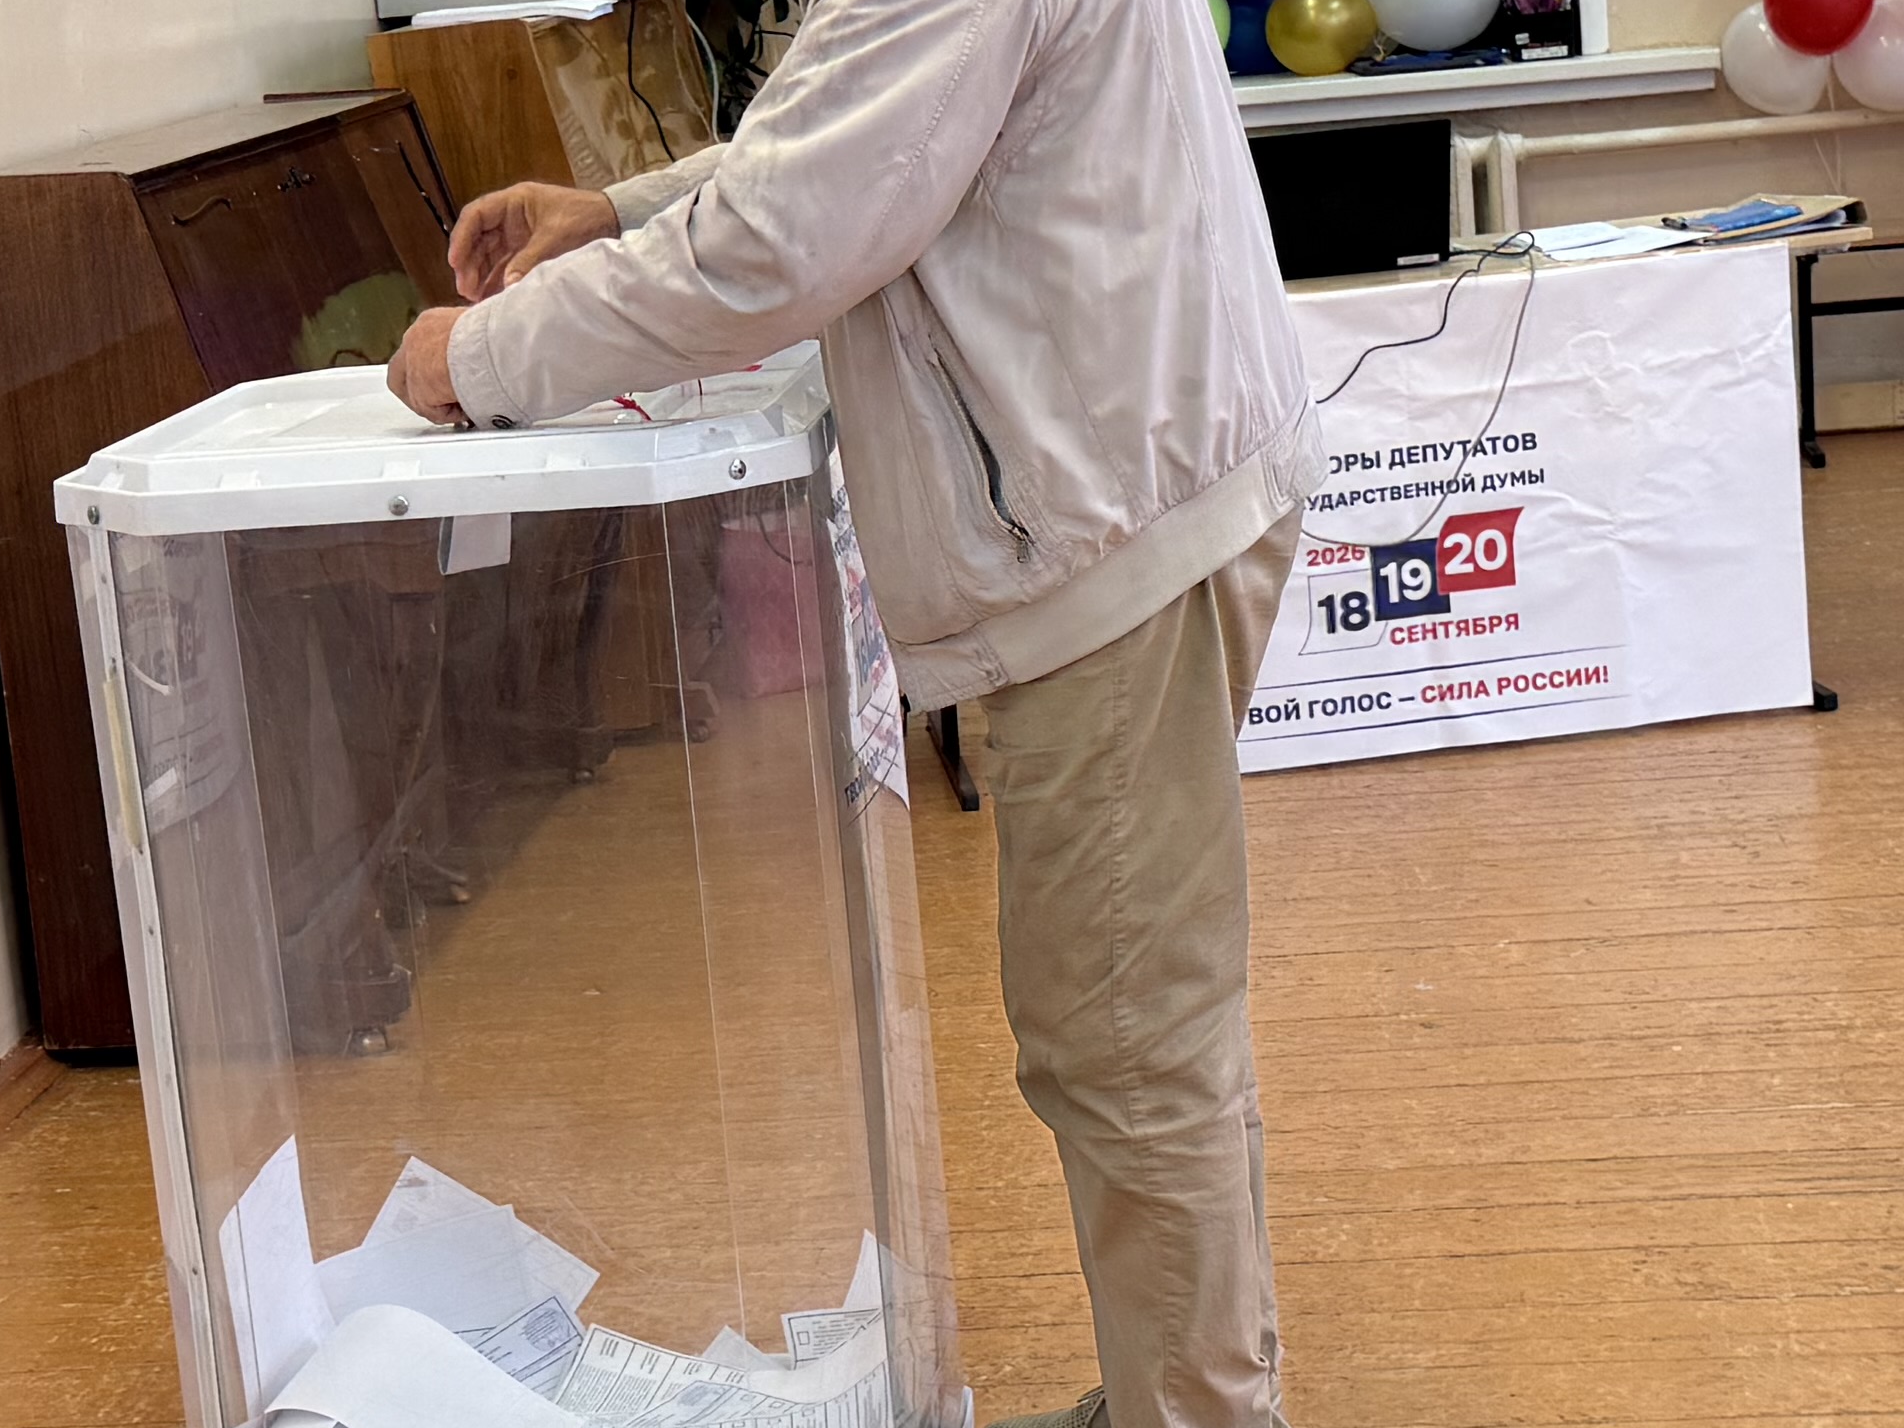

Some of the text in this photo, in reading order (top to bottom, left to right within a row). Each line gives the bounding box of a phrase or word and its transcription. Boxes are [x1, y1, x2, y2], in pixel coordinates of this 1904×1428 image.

[1328, 432, 1538, 475] ОРЫ ДЕПУТАТОВ
[1304, 468, 1546, 513] УДАРСТВЕННОЙ ДУМЫ
[1306, 543, 1366, 568] 2026
[1316, 528, 1508, 635] 18 19 20
[1388, 612, 1521, 646] СЕНТЯБРЯ
[1249, 697, 1301, 726] ВОЙ
[1307, 690, 1393, 720] ГОЛОС
[1419, 677, 1491, 705] СИЛА
[1496, 665, 1610, 696] РОССИИ!
